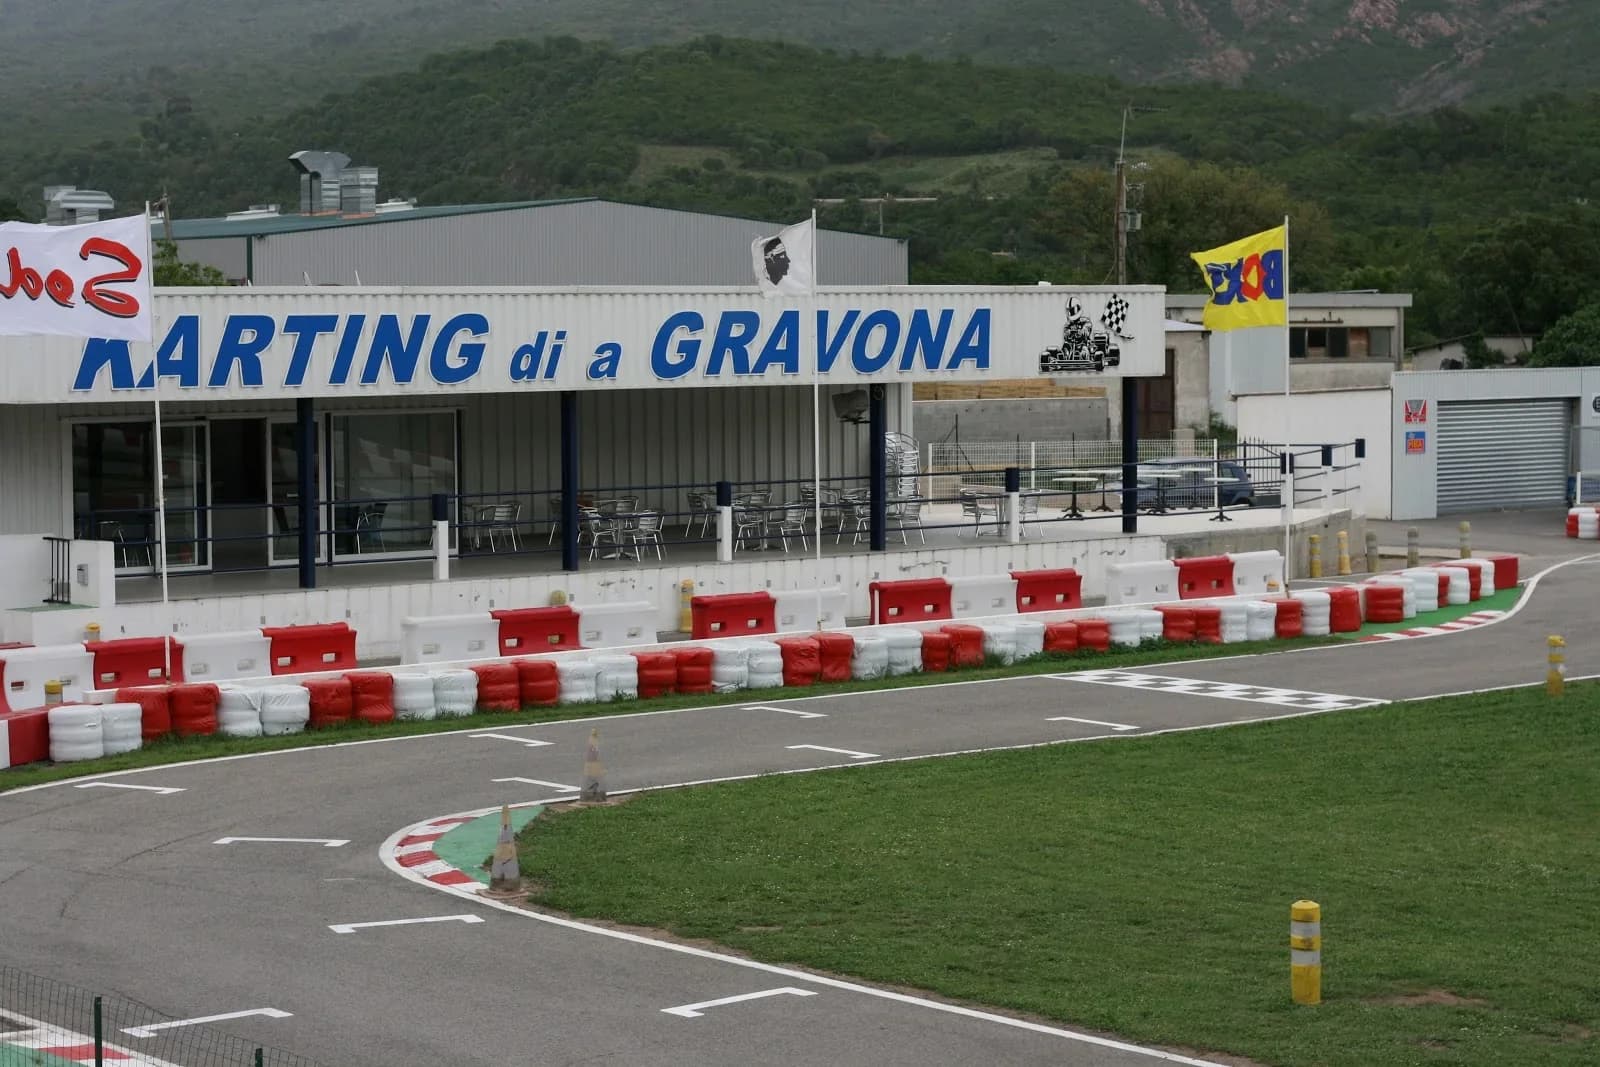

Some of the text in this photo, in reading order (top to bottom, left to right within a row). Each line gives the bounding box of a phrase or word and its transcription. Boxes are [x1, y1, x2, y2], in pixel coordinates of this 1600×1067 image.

[72, 308, 992, 391] KARTING di a GRAVONA
